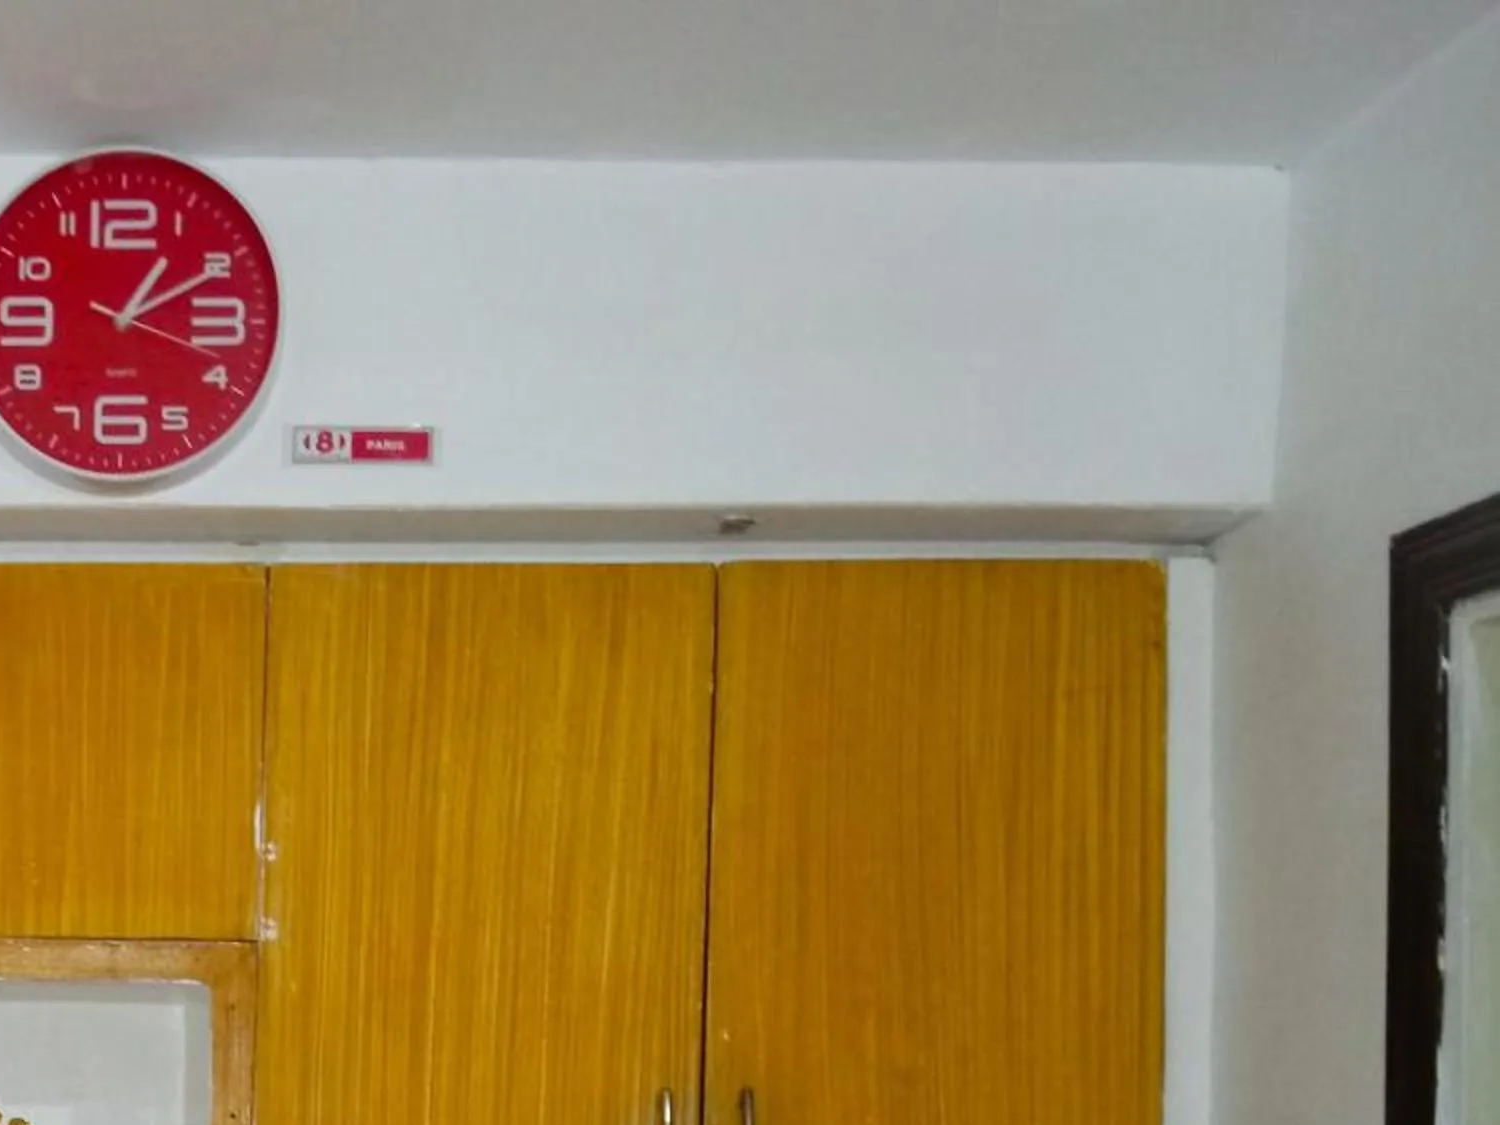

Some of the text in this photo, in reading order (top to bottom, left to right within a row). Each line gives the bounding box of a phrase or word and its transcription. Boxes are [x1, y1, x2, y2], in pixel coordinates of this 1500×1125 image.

[90, 199, 158, 249] 12
[18, 256, 51, 281] 10
[204, 252, 231, 278] 2
[0, 296, 54, 347] 9
[191, 297, 246, 346] 3
[13, 364, 42, 390] 8
[202, 365, 228, 389] 4
[53, 405, 81, 430] 7
[93, 395, 148, 445] 6
[161, 406, 189, 430] 5
